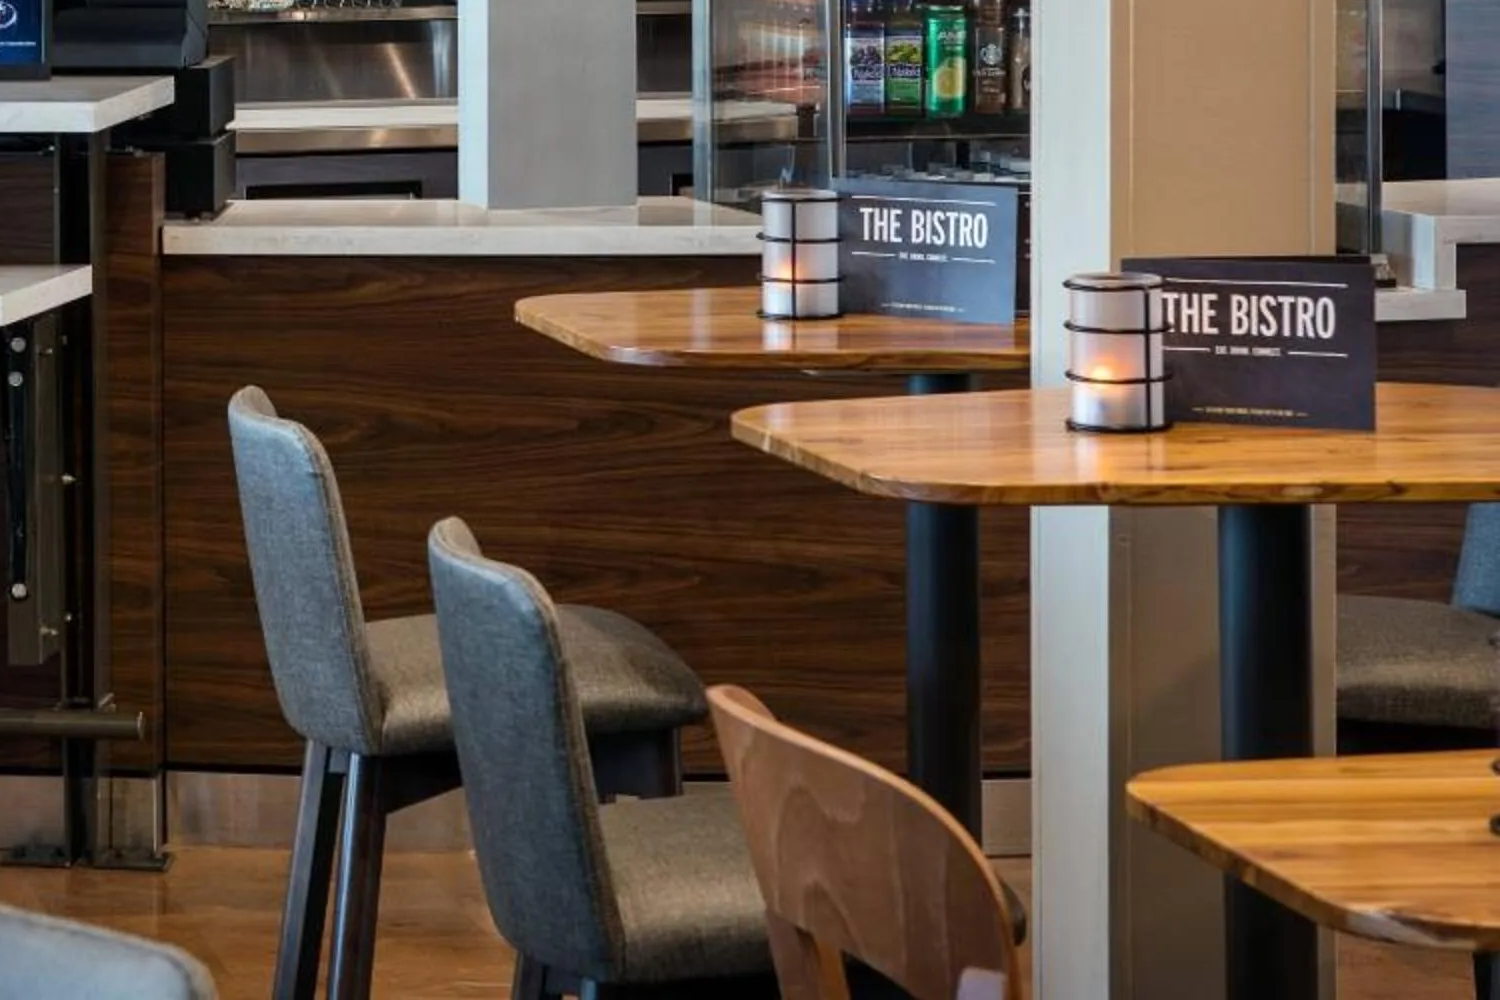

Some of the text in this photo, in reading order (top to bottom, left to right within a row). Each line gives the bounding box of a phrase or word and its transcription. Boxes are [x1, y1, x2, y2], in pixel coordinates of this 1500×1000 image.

[860, 207, 988, 248] THE BISTRO
[1161, 292, 1336, 339] THE BISTRO
